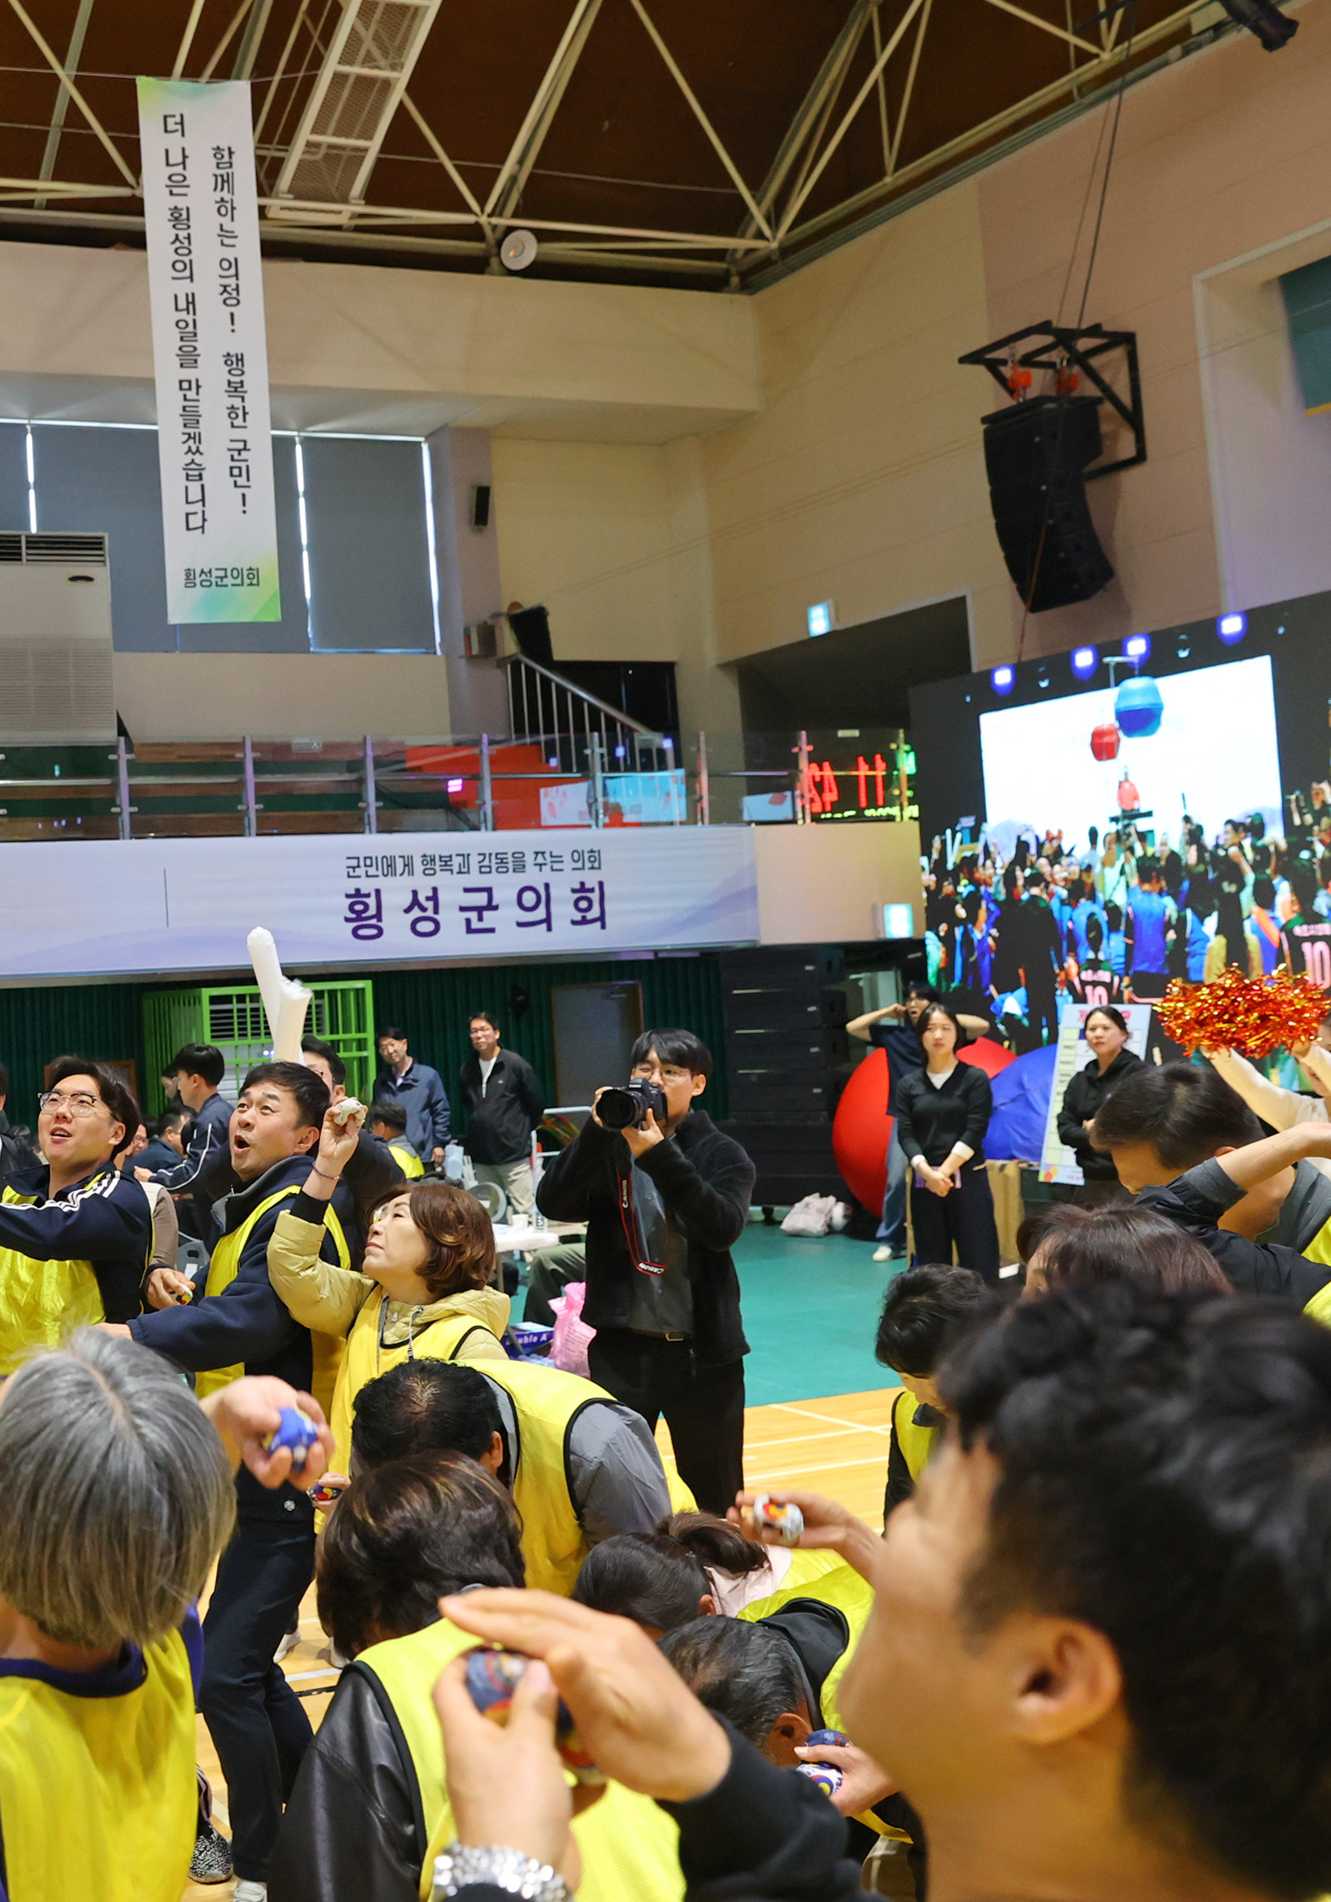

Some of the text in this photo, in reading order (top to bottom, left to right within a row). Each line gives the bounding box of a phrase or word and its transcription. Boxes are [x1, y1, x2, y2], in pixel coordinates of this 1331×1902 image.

[163, 113, 208, 535] 더 나은 횡성의 내일을 만들겠습니다
[211, 145, 251, 515] 함께하는 의정! 행복한 군민!
[184, 566, 260, 589] 횡성군의회
[345, 848, 602, 879] 군민에게 행복과 감동을 주는 의회
[343, 880, 607, 941] 횡성군의회
